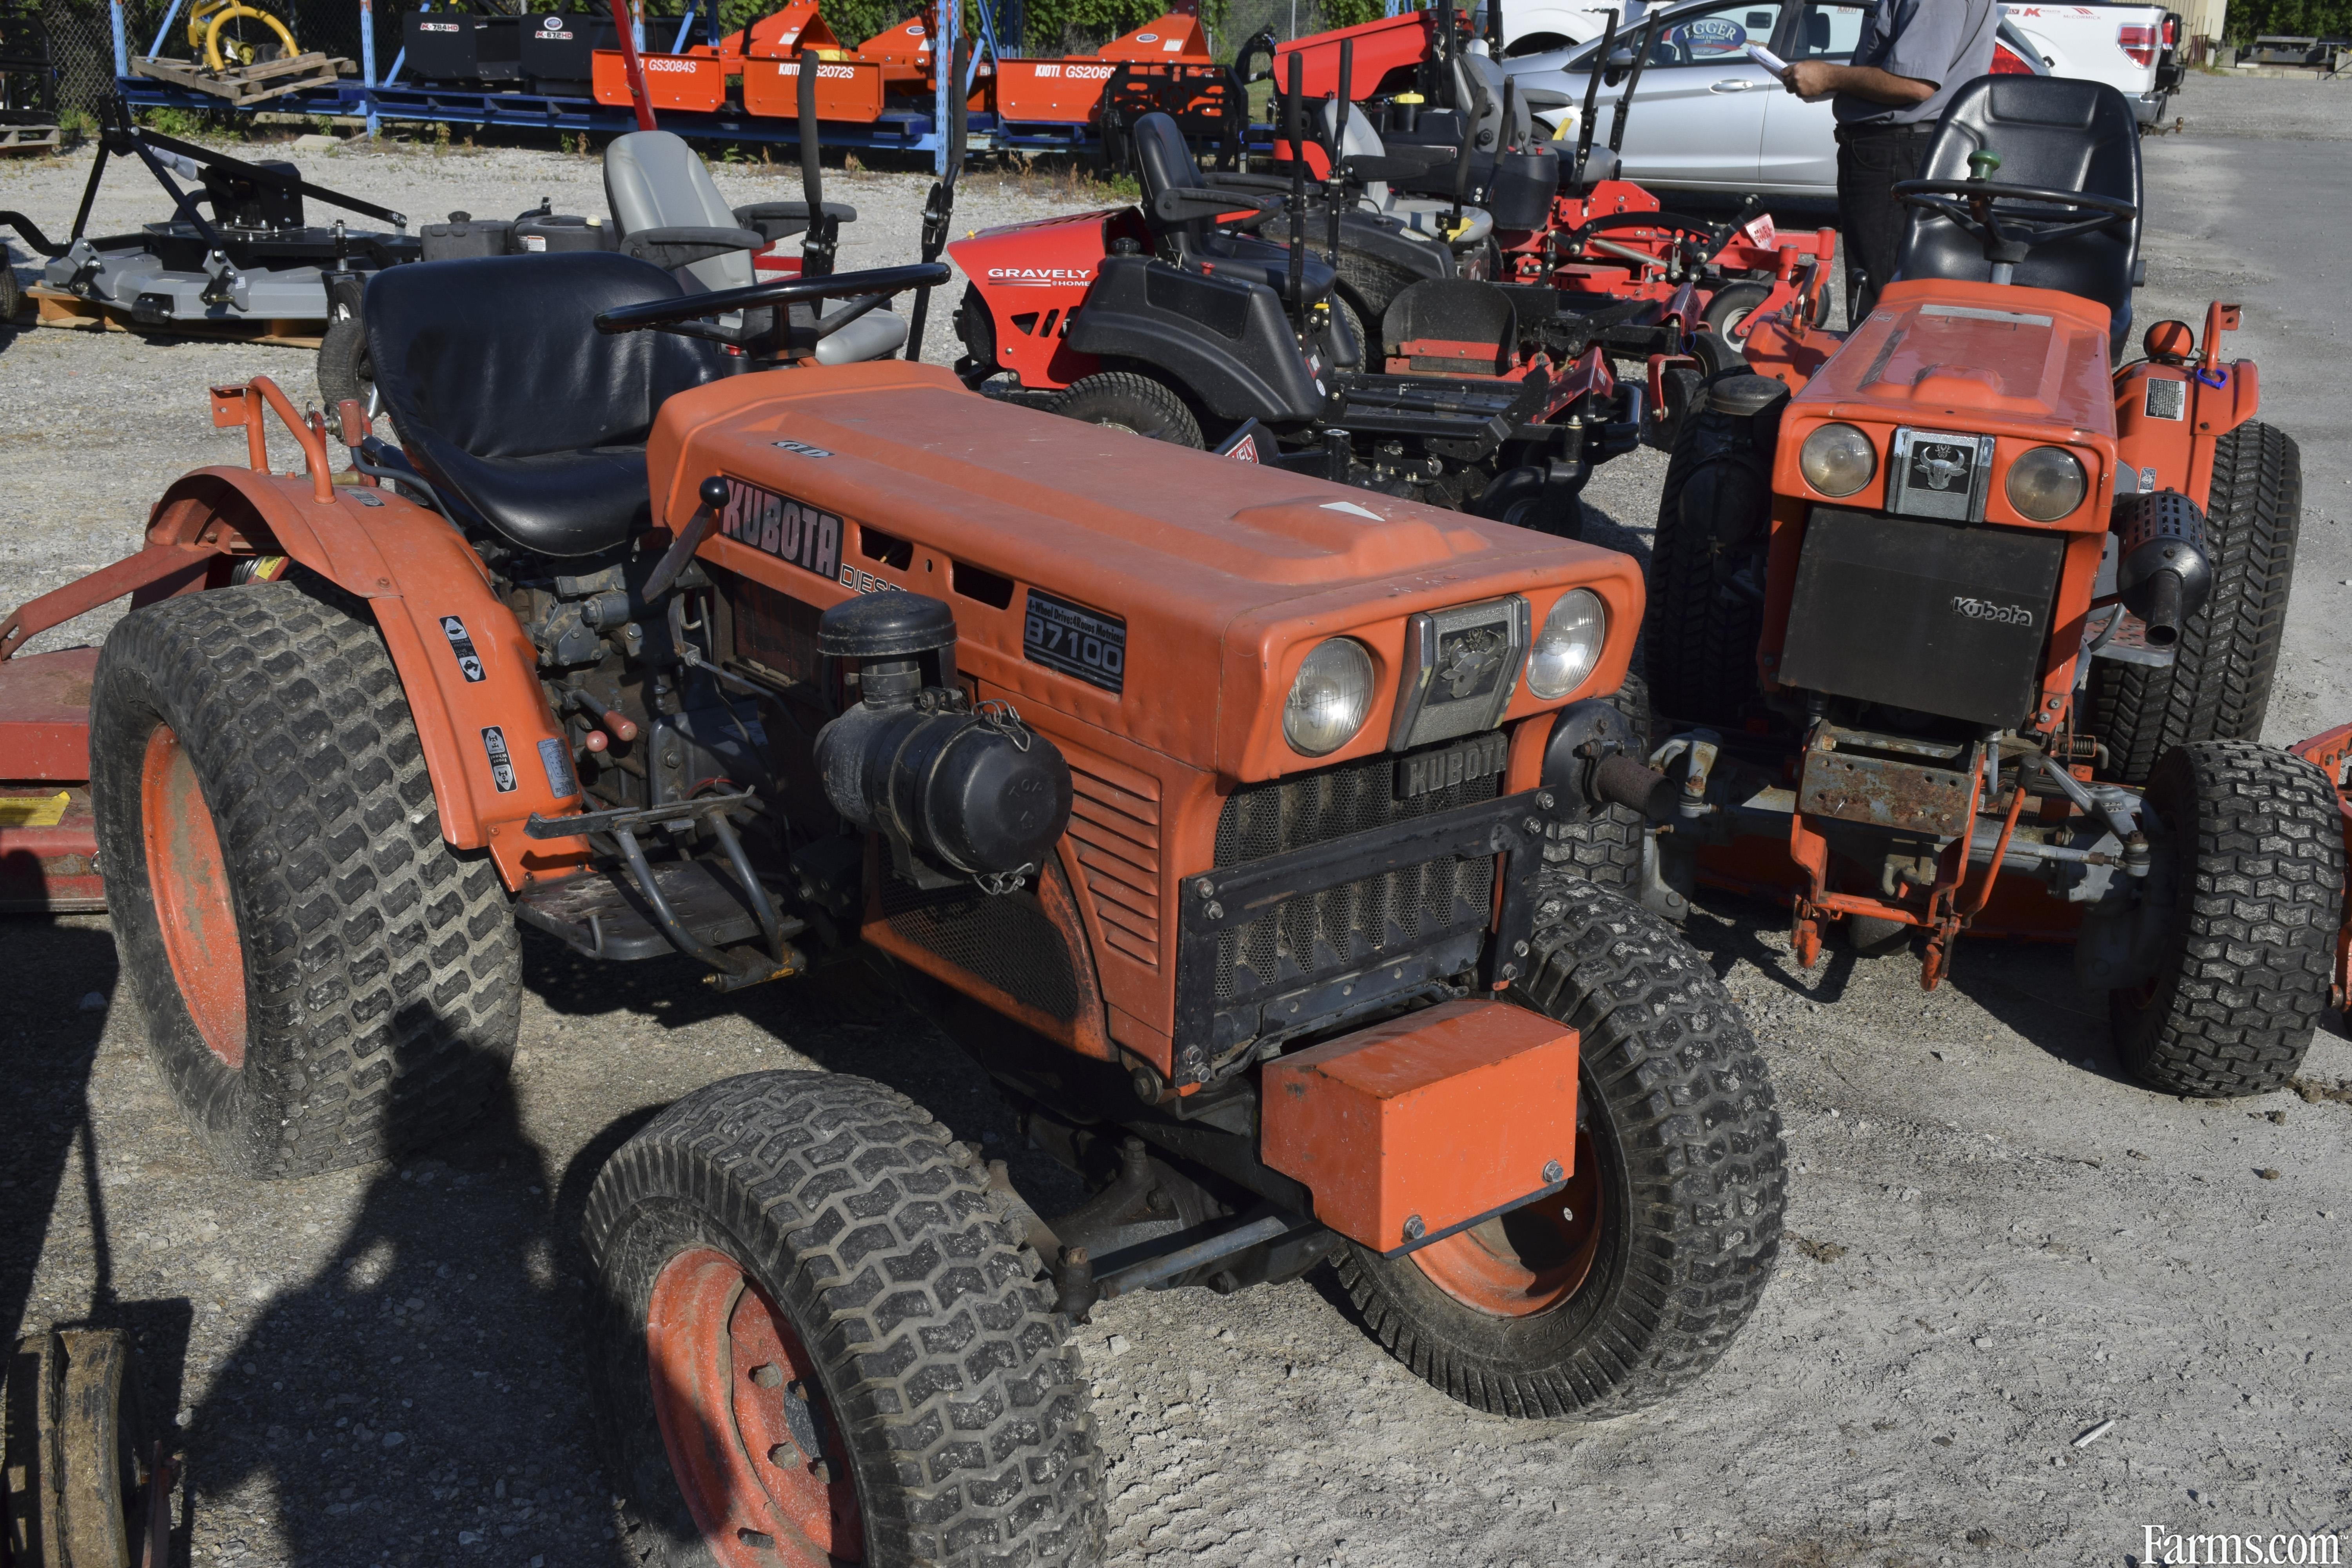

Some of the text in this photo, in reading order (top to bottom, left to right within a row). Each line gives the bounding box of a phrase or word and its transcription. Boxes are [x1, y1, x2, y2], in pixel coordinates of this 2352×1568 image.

[649, 59, 696, 73] GS3084S
[1035, 65, 1060, 77] KIOTI
[988, 269, 1091, 278] GRAVELY
[722, 479, 838, 578] KUBOTA
[840, 563, 907, 594] DIES
[1952, 596, 2033, 627] Kubota
[1025, 614, 1123, 674] B7100
[1096, 623, 1123, 644] Motrices
[1409, 740, 1508, 797] KUBOTA
